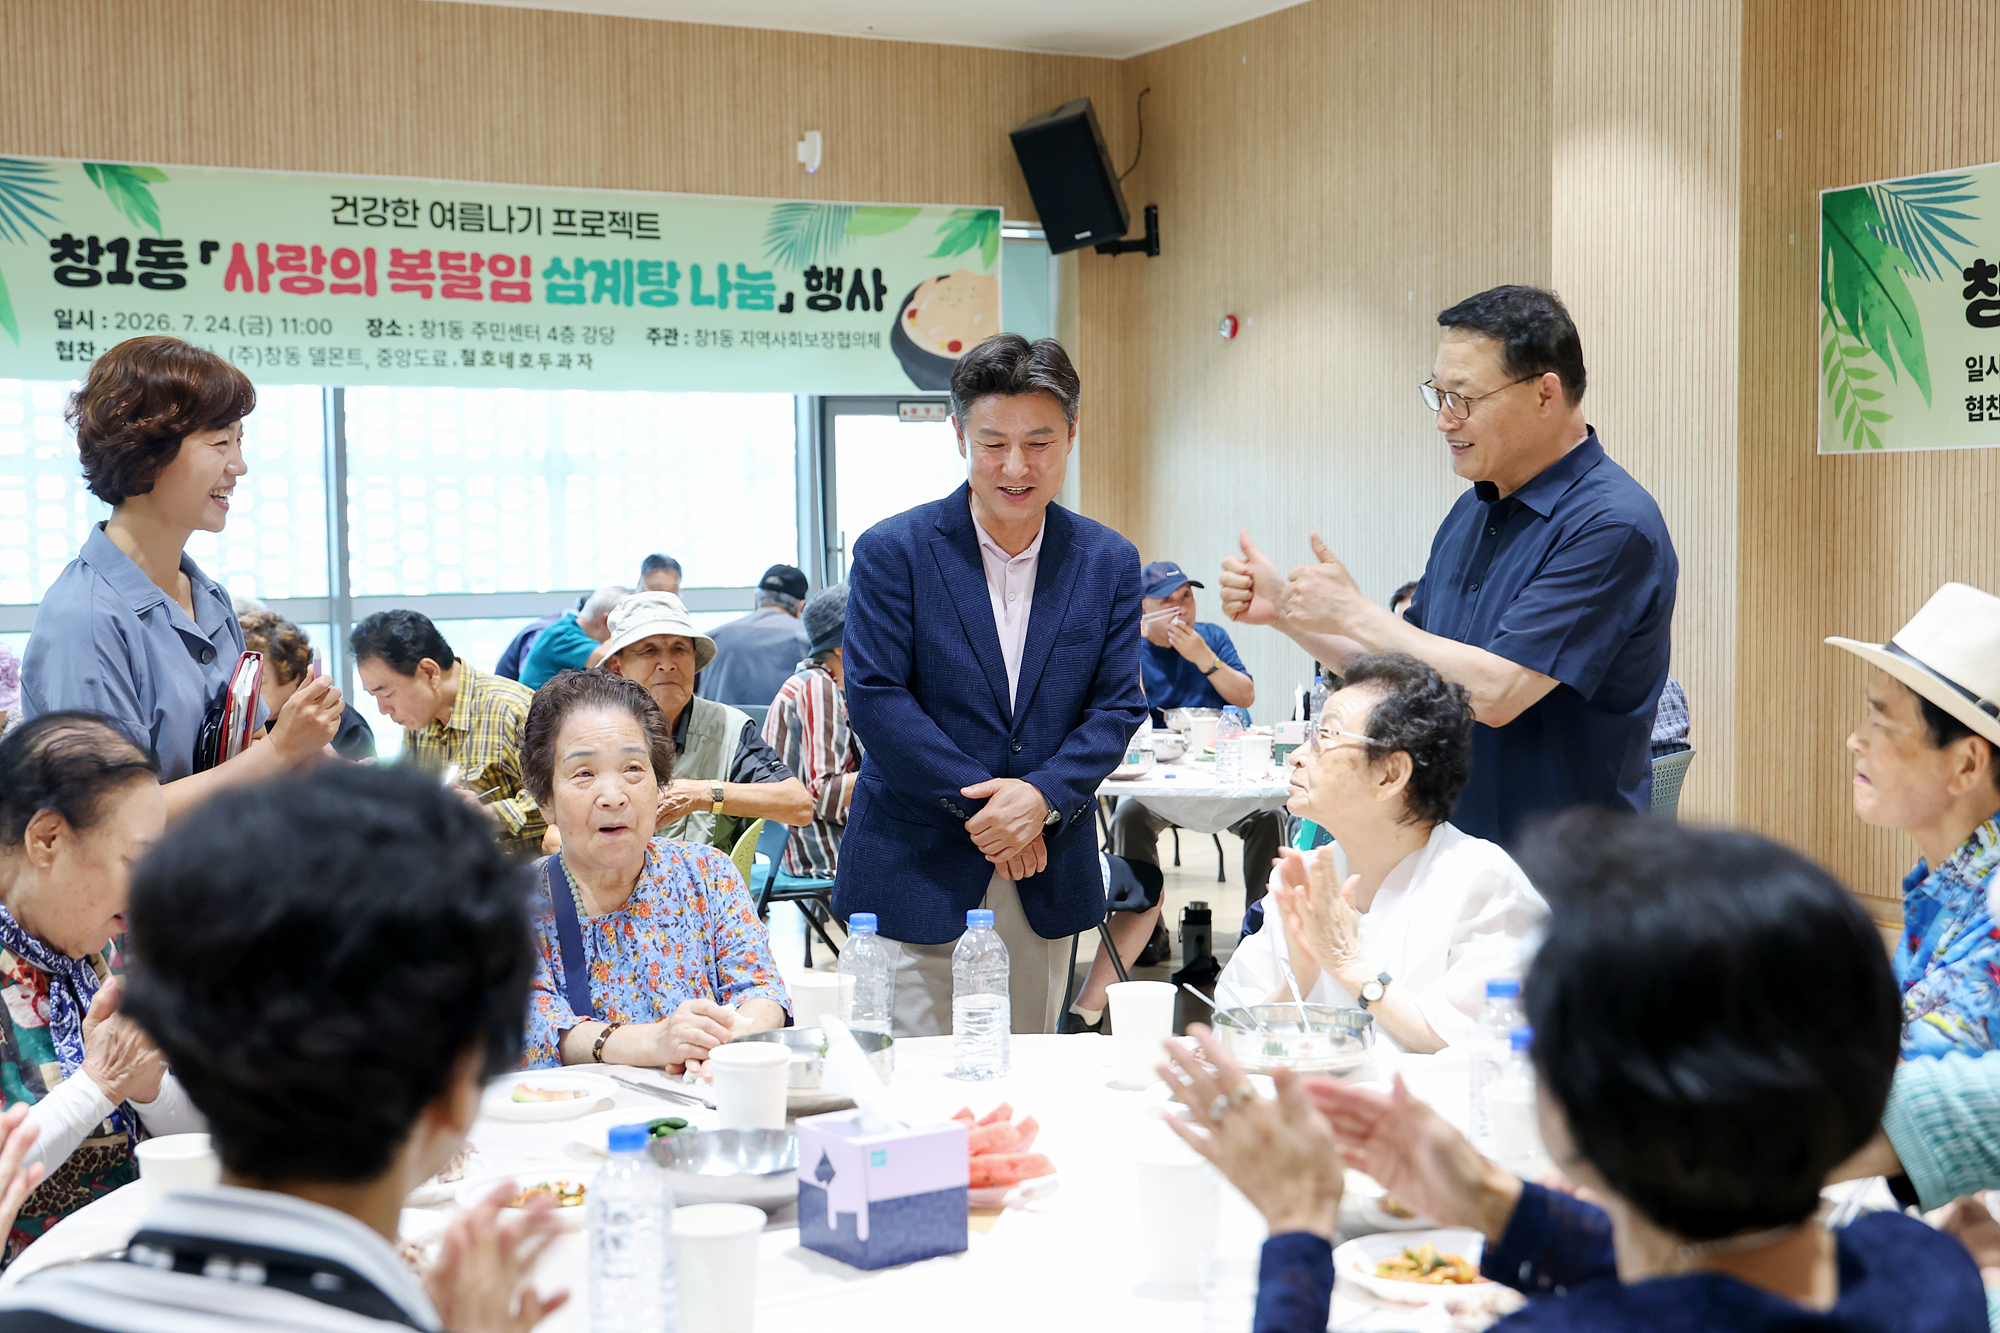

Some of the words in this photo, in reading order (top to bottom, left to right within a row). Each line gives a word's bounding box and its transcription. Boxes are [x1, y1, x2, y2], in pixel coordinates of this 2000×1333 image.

[331, 195, 421, 229] 건강한
[429, 200, 542, 236] 여름나기
[552, 208, 661, 240] 프로젝트
[49, 233, 189, 291] 창1동
[386, 248, 533, 304] 복달임
[542, 256, 682, 308] 삼계탕
[803, 264, 888, 313] 행사
[54, 308, 94, 331] 일시
[114, 311, 176, 333] 2026.
[279, 317, 334, 336] 11:00
[366, 317, 404, 339] 장소
[419, 318, 464, 341] 창1동
[470, 320, 541, 343] 주민센터
[546, 325, 576, 345] 4층
[581, 325, 616, 346] 강당
[55, 340, 95, 362] 협찬
[646, 326, 679, 347] 주관
[694, 328, 734, 348] 창1동
[739, 329, 881, 350] 지역사회보장협의체
